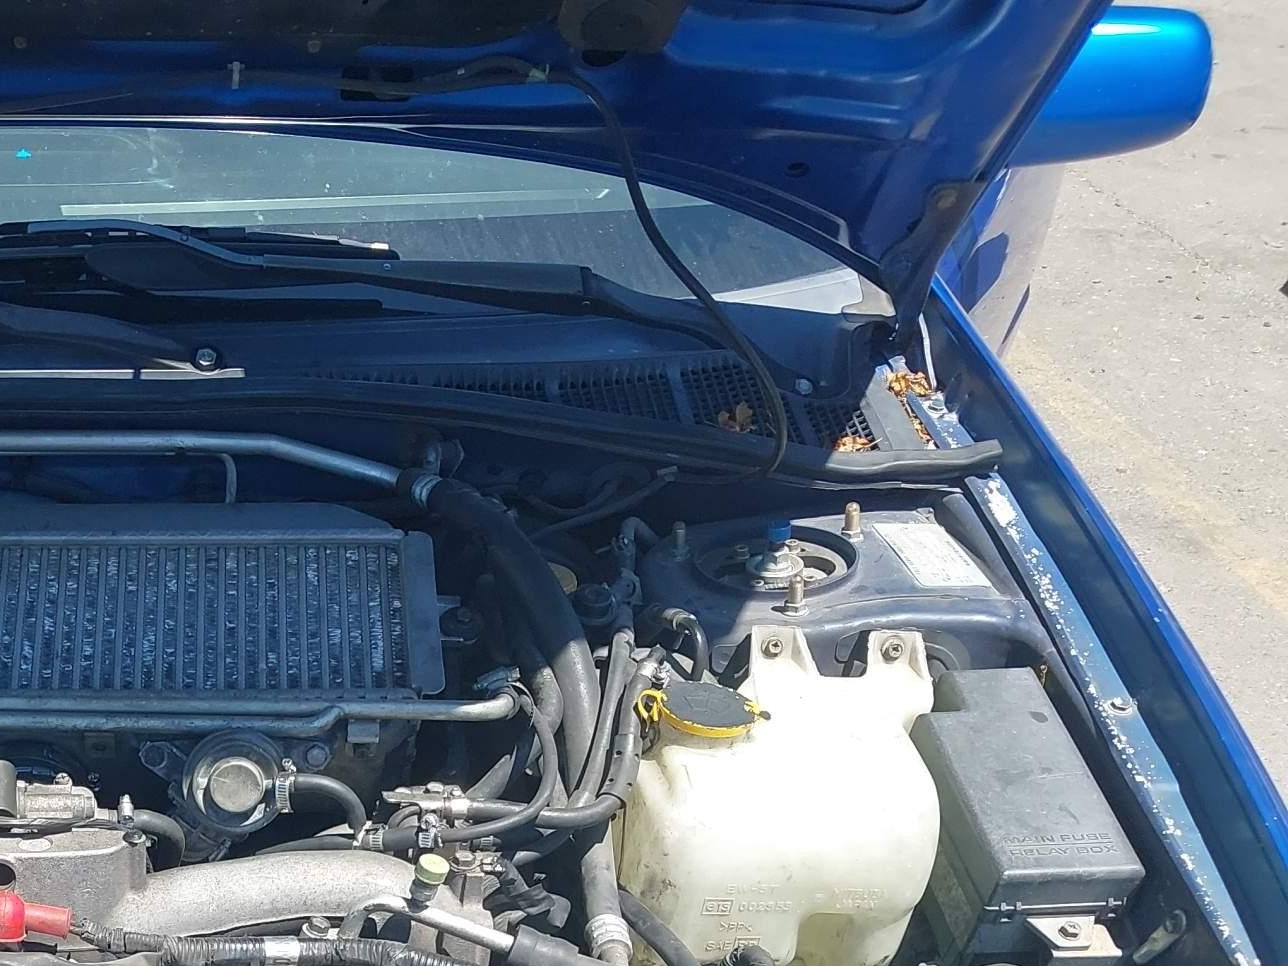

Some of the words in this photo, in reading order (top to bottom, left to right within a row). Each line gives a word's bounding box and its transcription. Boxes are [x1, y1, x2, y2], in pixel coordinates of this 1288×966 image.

[1003, 834, 1056, 844] MAIN
[1059, 832, 1113, 843] FUSE
[1010, 846, 1070, 856] RELAY
[1076, 844, 1119, 855] BOX
